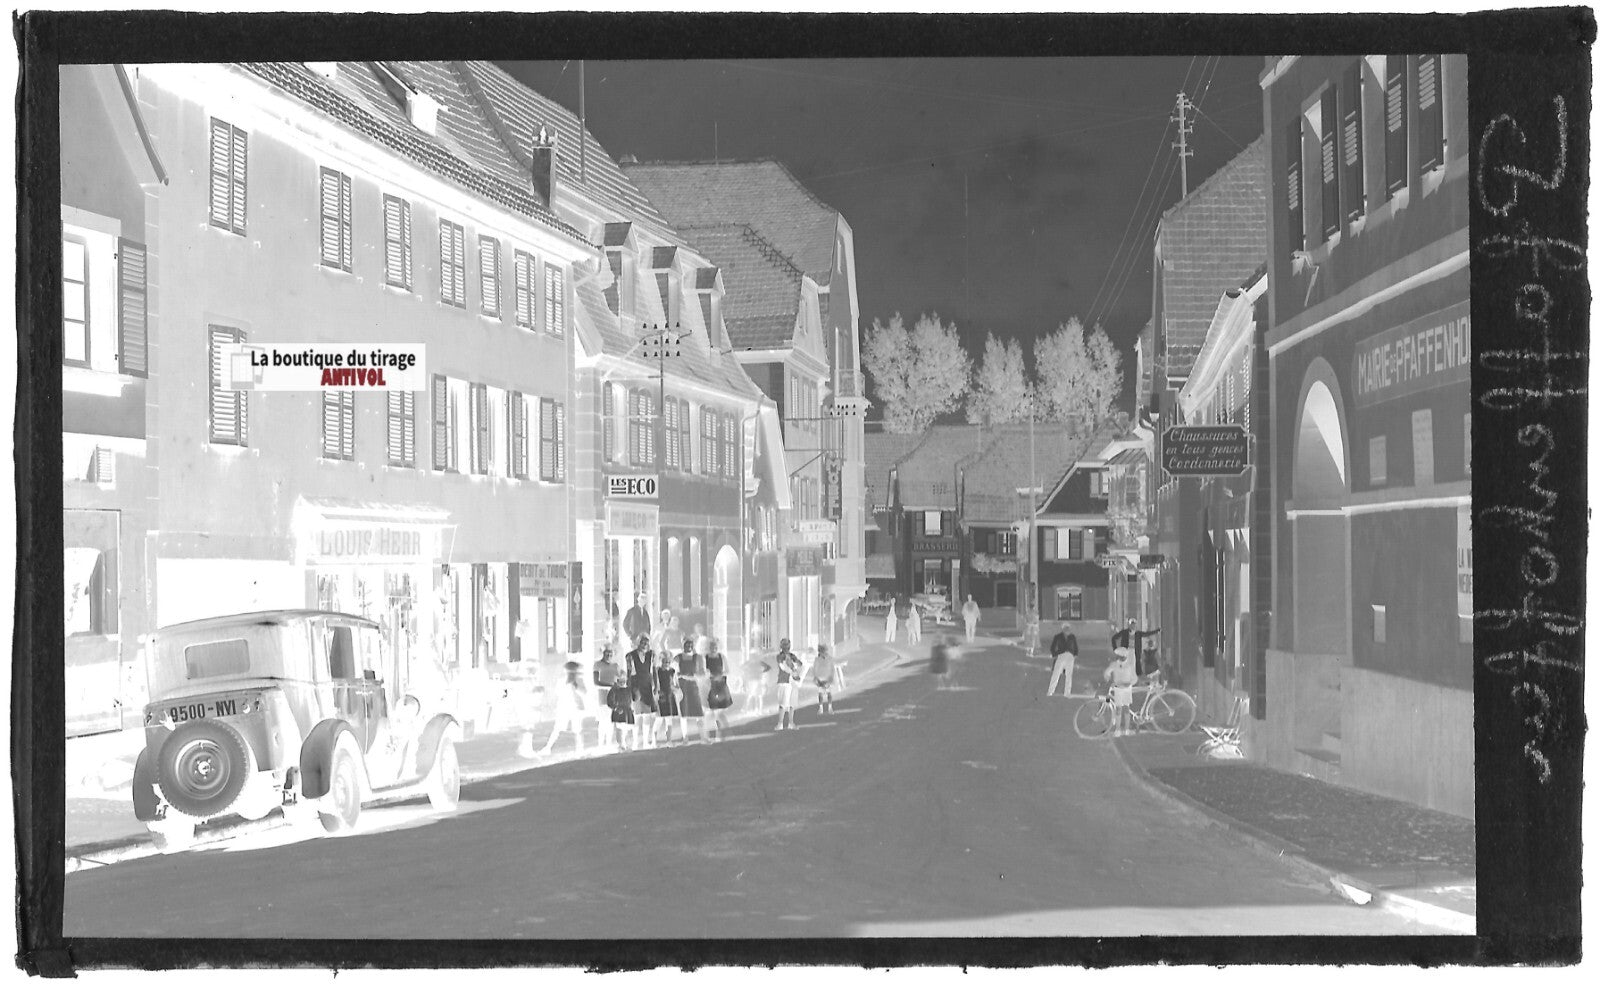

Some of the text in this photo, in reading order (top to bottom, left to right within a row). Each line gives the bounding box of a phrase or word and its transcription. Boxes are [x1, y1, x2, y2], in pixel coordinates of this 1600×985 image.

[1358, 344, 1391, 395] MAIRIE
[1170, 430, 1239, 442] Chaussures
[1165, 447, 1177, 455] en
[1168, 457, 1241, 469] Cordonnerie
[611, 478, 656, 495] LES ECO
[320, 527, 421, 557] LOUIS HERR
